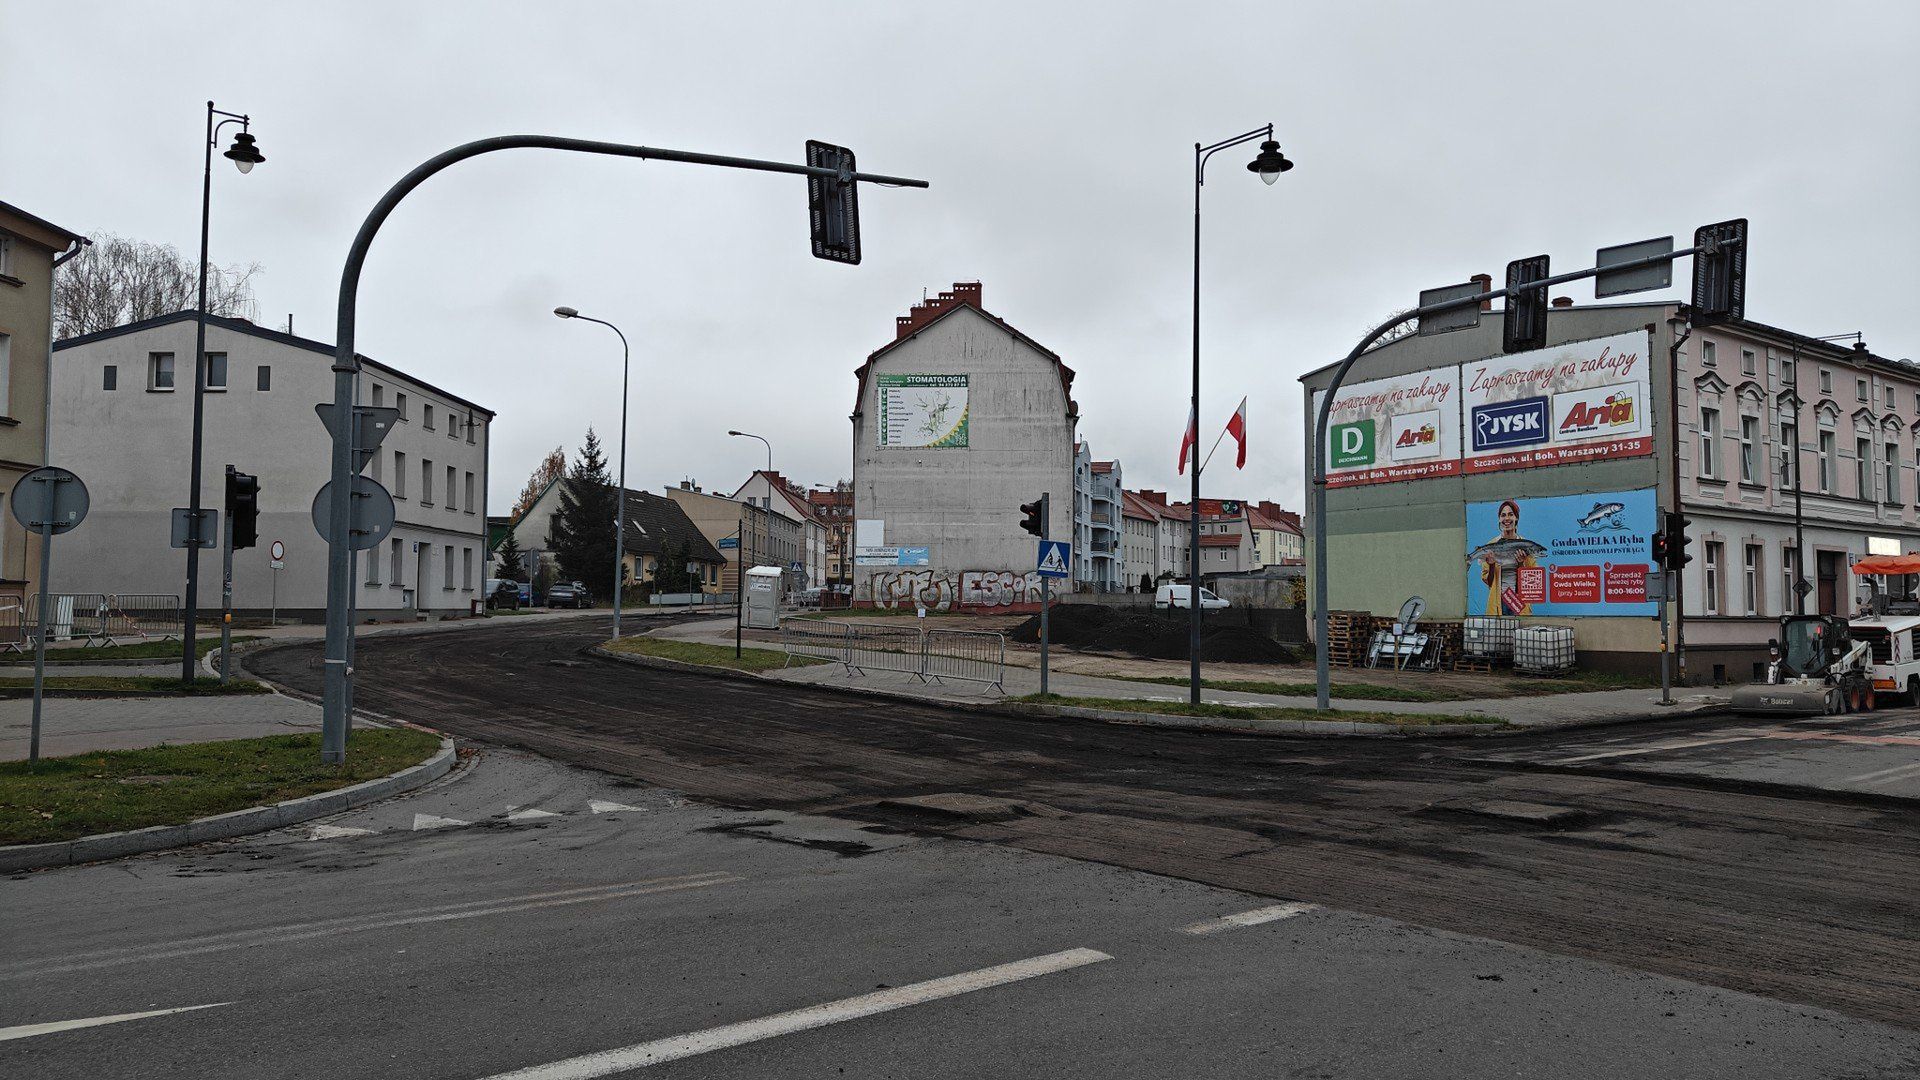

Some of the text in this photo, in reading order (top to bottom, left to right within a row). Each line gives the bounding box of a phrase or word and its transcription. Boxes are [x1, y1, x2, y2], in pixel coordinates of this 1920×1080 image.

[1470, 346, 1638, 398] Zapraszamy na zakupy
[1329, 376, 1451, 419] apraszamy na zakupy
[1490, 412, 1541, 435] JYSK
[1560, 396, 1633, 430] Aria
[1342, 427, 1364, 454] D
[1396, 425, 1435, 446] Aria
[1474, 441, 1641, 468] Szczecinek, ul. Boh. Warszawy 31-35
[1359, 472, 1369, 480] ul.
[1370, 470, 1387, 479] Boh.
[1388, 466, 1428, 477] Warszawy
[1429, 463, 1452, 472] 31-35
[1619, 534, 1645, 547] Ryba
[1609, 571, 1641, 580] Sprzedaż
